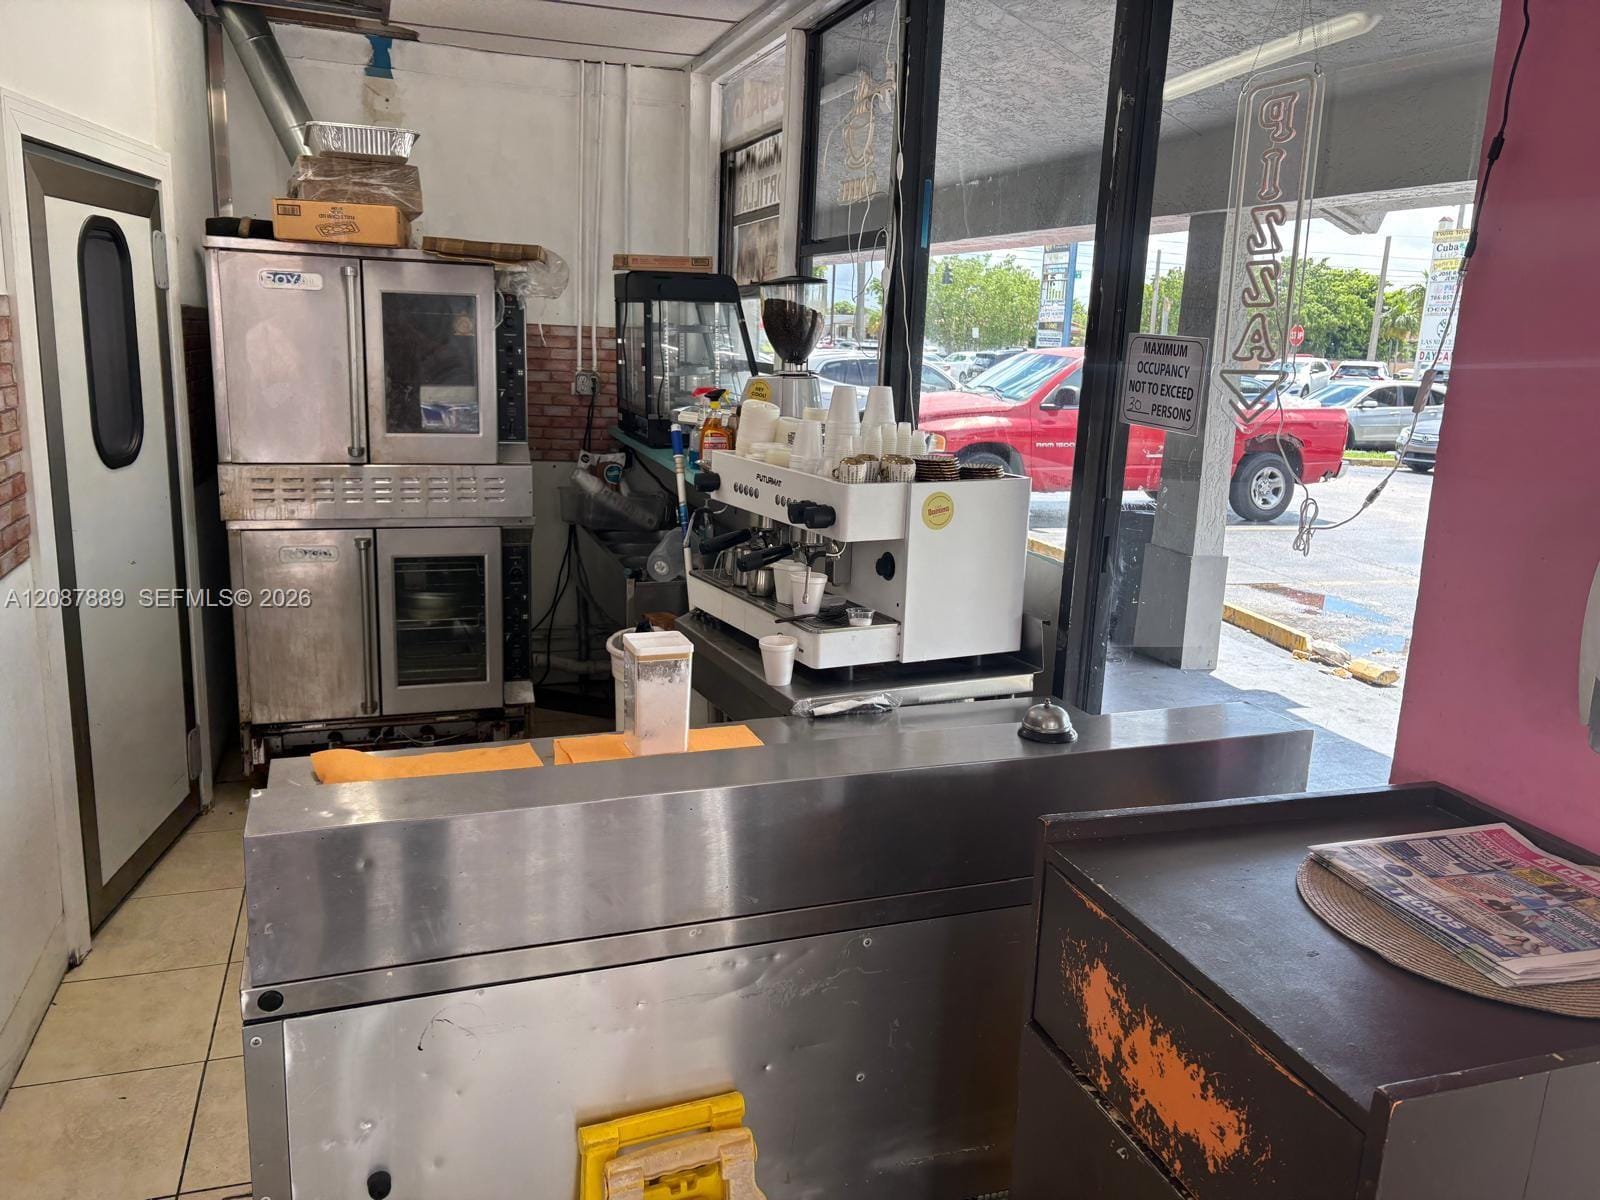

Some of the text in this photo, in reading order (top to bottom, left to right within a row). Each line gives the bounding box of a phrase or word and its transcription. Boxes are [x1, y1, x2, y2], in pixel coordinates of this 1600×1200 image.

[1436, 243, 1459, 252] Cuba
[1290, 331, 1304, 340] STOP
[1142, 341, 1189, 358] MAXIMUM
[1137, 361, 1191, 379] OCCUPANCY
[1128, 379, 1194, 401] NOT TO EXCEED
[1150, 403, 1192, 422] PERSONS
[1390, 888, 1468, 928] TECHOS
